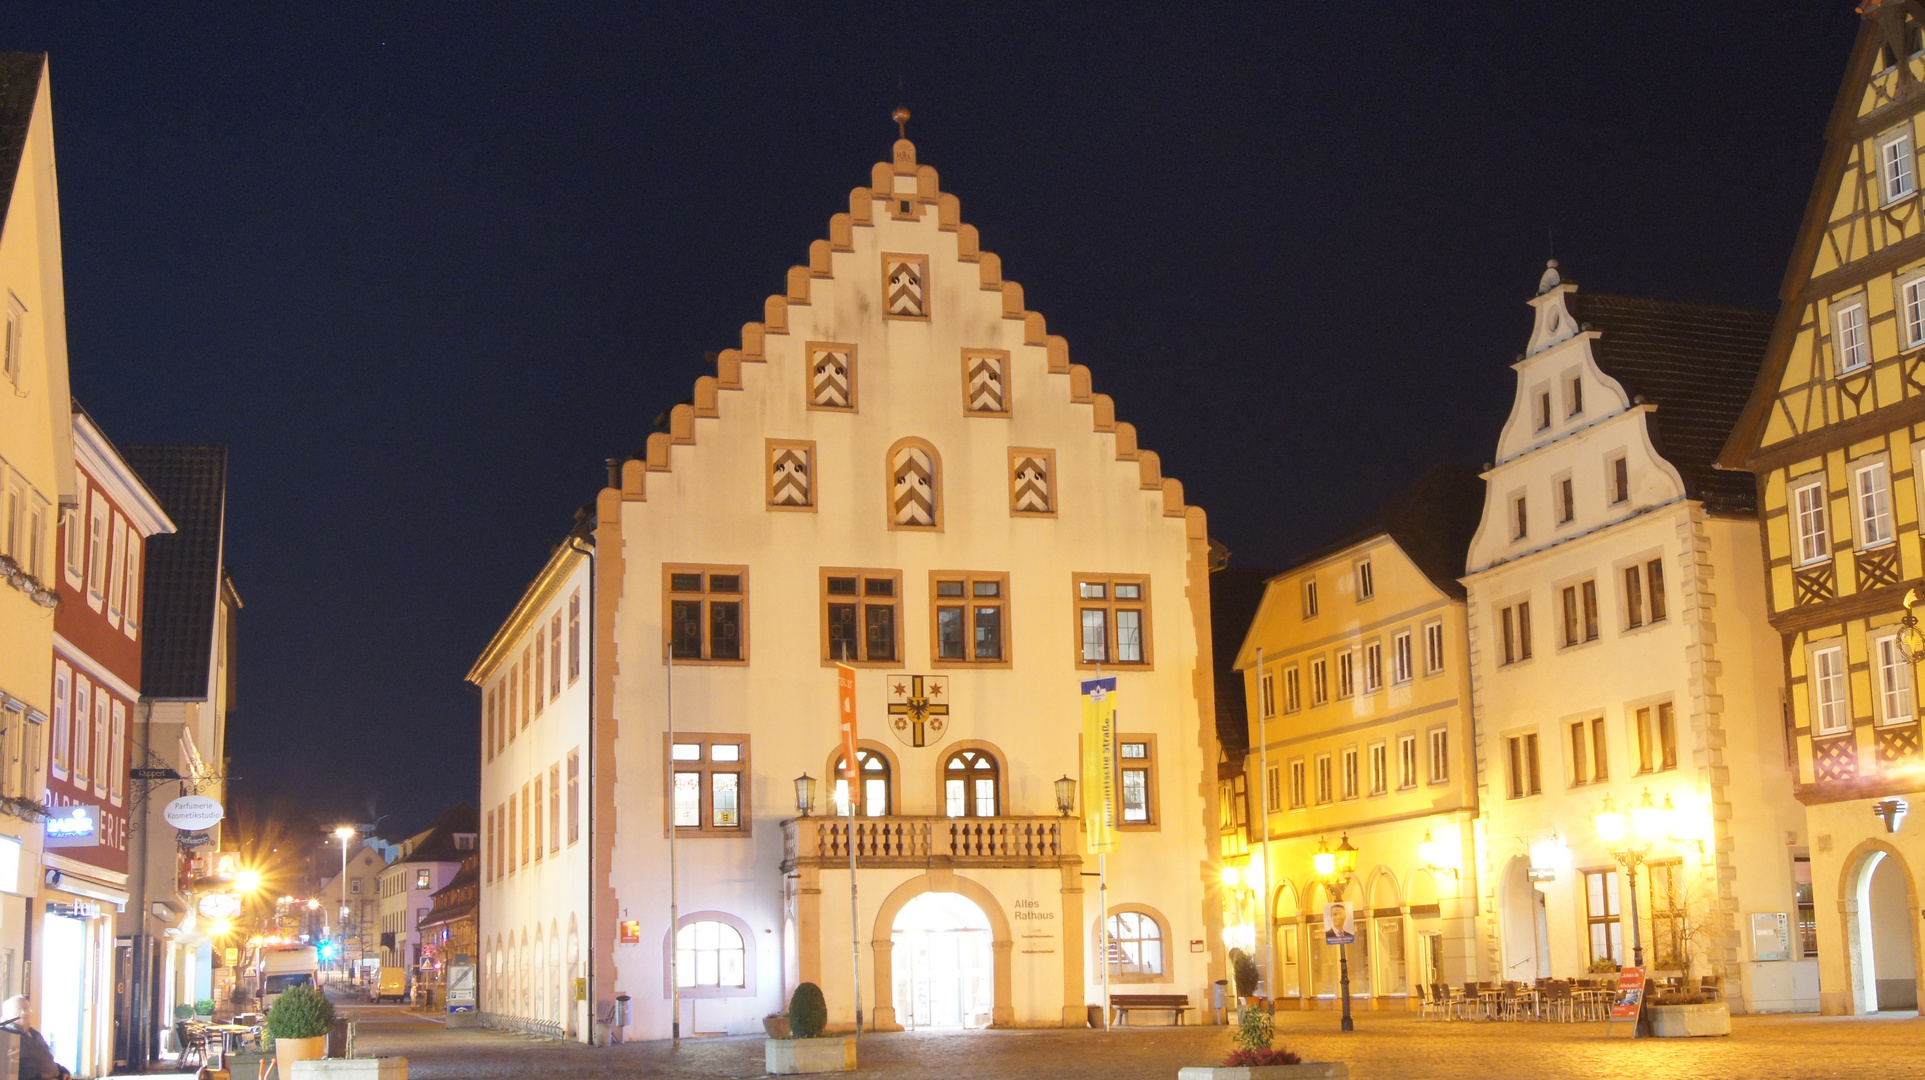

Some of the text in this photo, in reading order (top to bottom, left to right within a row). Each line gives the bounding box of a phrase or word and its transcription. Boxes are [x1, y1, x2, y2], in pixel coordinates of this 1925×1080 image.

[45, 788, 126, 851] PERIE
[1014, 899, 1040, 908] Altes
[623, 908, 628, 917] 1
[1014, 911, 1055, 920] Rathaus
